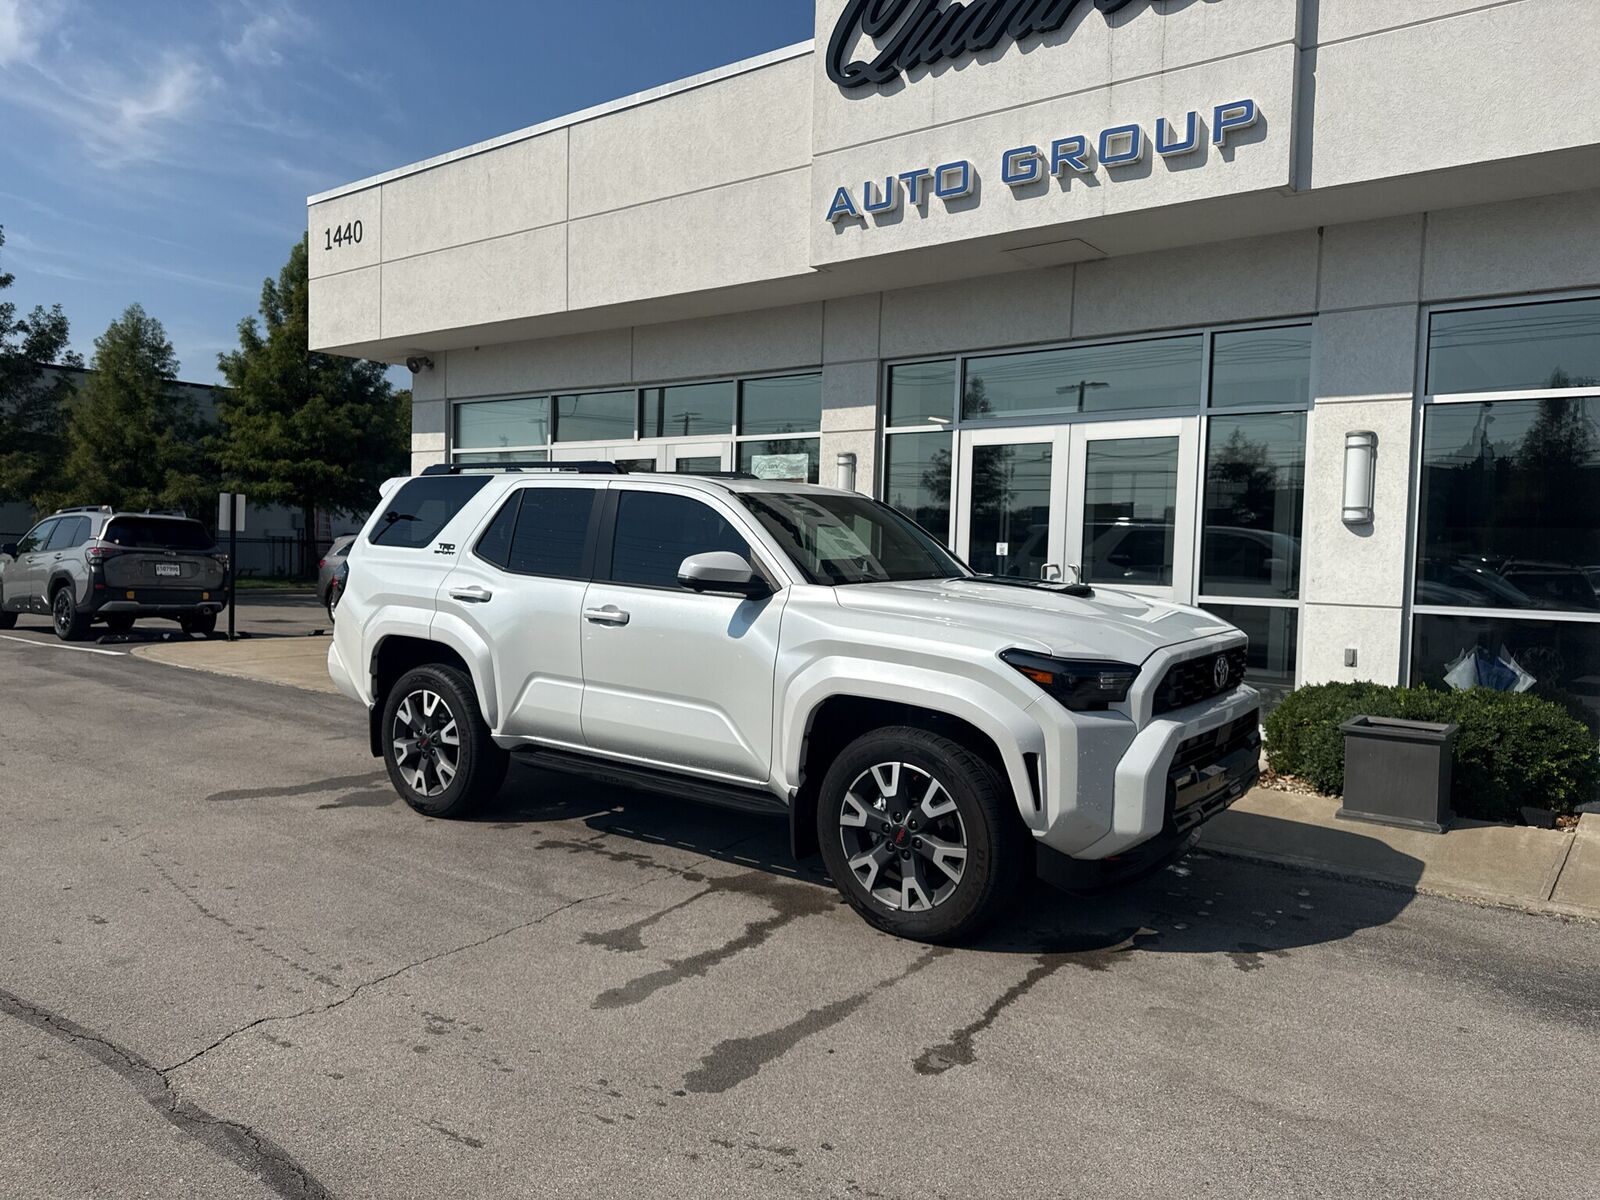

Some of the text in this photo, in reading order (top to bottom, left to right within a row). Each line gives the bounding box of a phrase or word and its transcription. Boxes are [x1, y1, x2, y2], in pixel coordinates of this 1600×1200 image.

[826, 99, 1258, 222] AUTO GROUP
[325, 220, 363, 250] 1440
